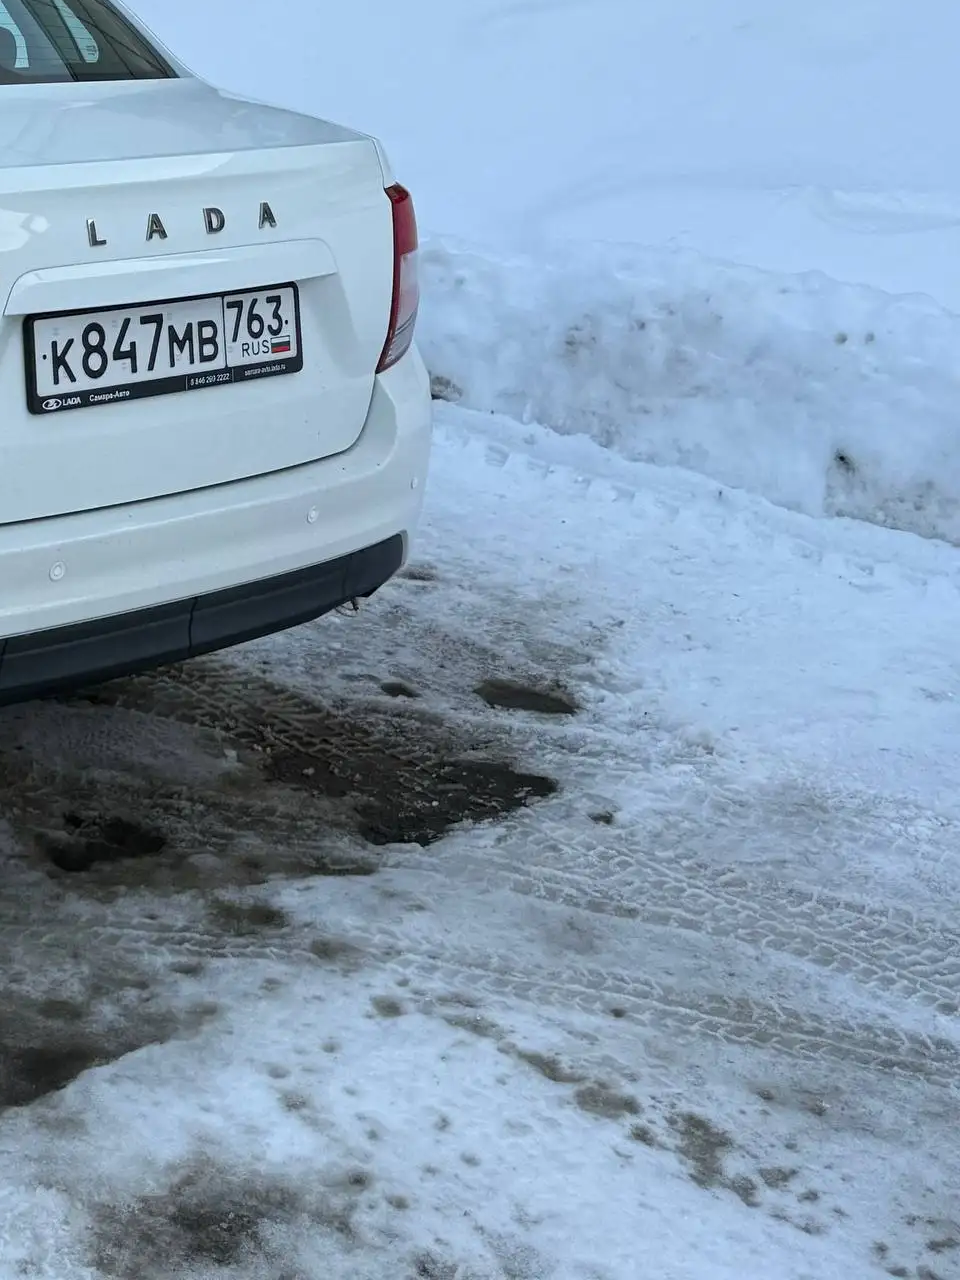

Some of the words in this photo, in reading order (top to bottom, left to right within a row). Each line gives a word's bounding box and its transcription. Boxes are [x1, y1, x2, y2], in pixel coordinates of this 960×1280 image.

[86, 201, 278, 247] LADA
[226, 295, 283, 342] 763
[242, 340, 270, 357] RUS
[63, 397, 82, 406] LADA
